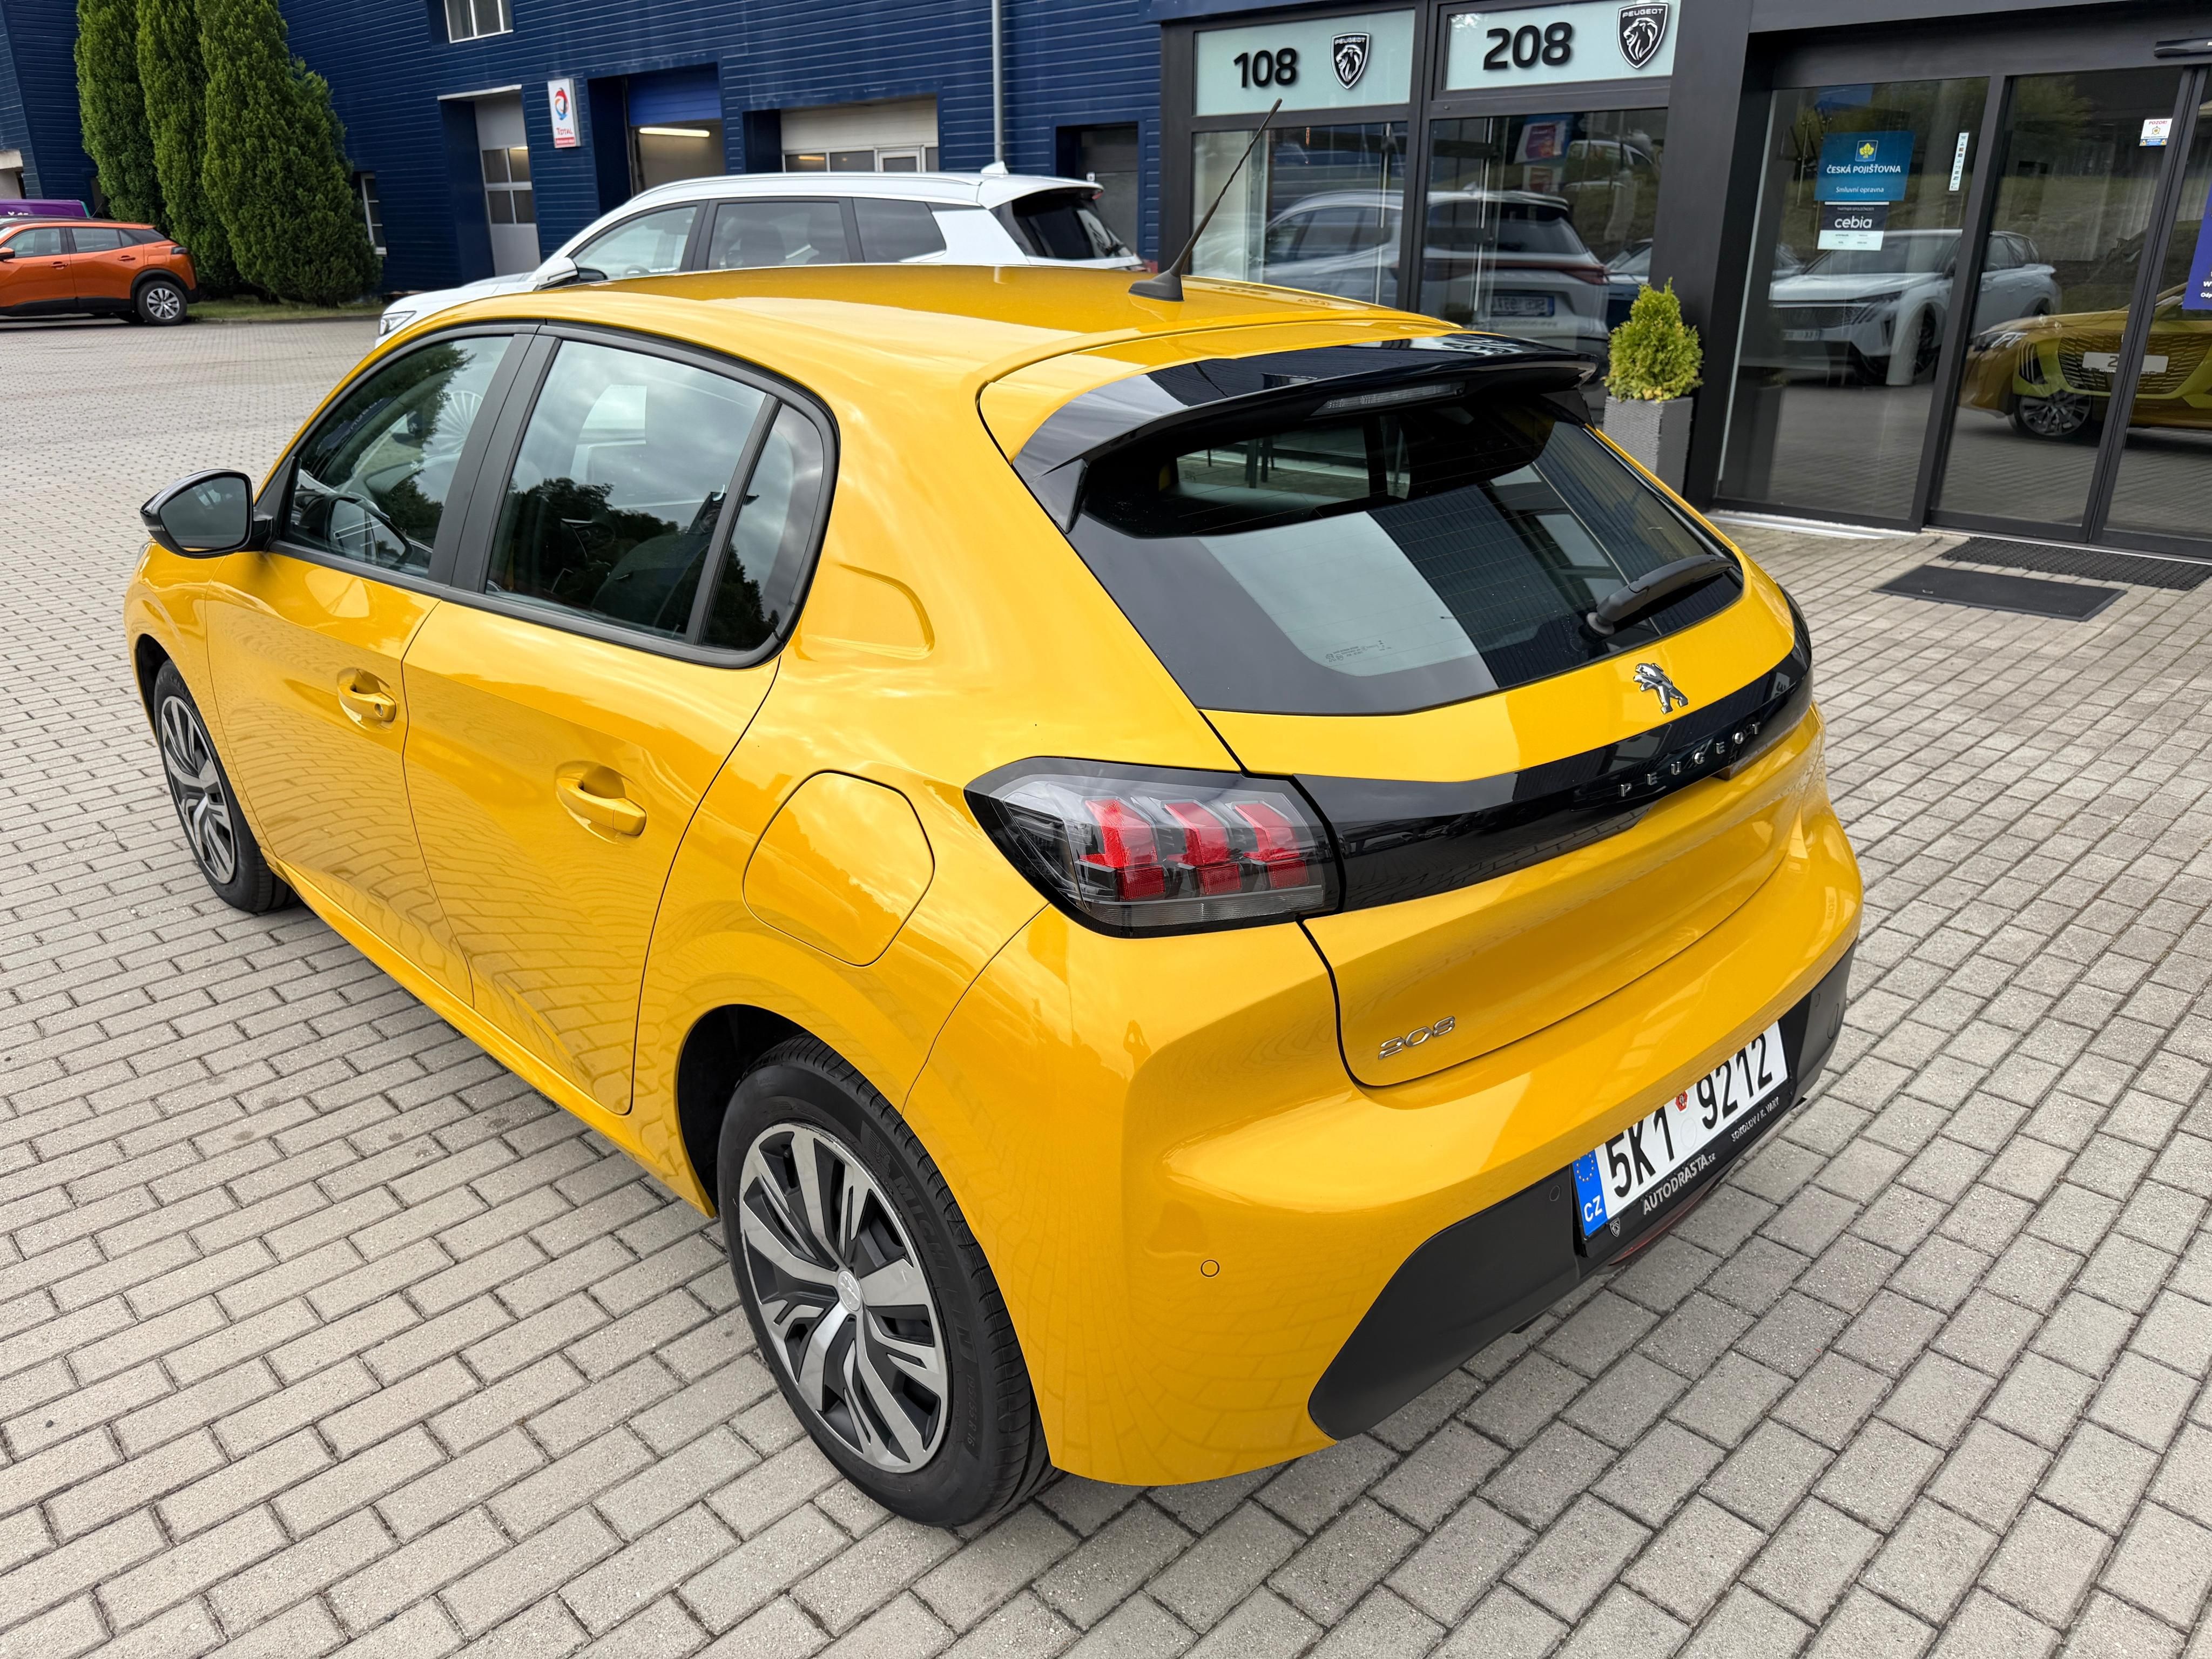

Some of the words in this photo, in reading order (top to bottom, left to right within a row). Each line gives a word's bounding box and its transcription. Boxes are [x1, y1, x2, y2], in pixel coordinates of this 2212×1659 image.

[1622, 8, 1663, 18] PEUGEOT
[1334, 37, 1366, 45] PEUGEOT
[1483, 22, 1572, 70] 208
[1233, 48, 1297, 88] 108
[1826, 164, 1851, 174] ČESKÁ
[1853, 164, 1901, 174] POJIŠŤOVNA
[1835, 215, 1872, 228] cebia
[1619, 721, 1761, 797] PEUGEOT
[1378, 1016, 1455, 1060] 208
[1605, 1105, 1674, 1198] 5K1
[1696, 1033, 1773, 1130] 9212
[1731, 1116, 1756, 1142] SOKOLOV
[1765, 1097, 1779, 1112] VARY
[1642, 1152, 1716, 1215] AUTODRASTA.cz
[1584, 1195, 1602, 1222] CZ
